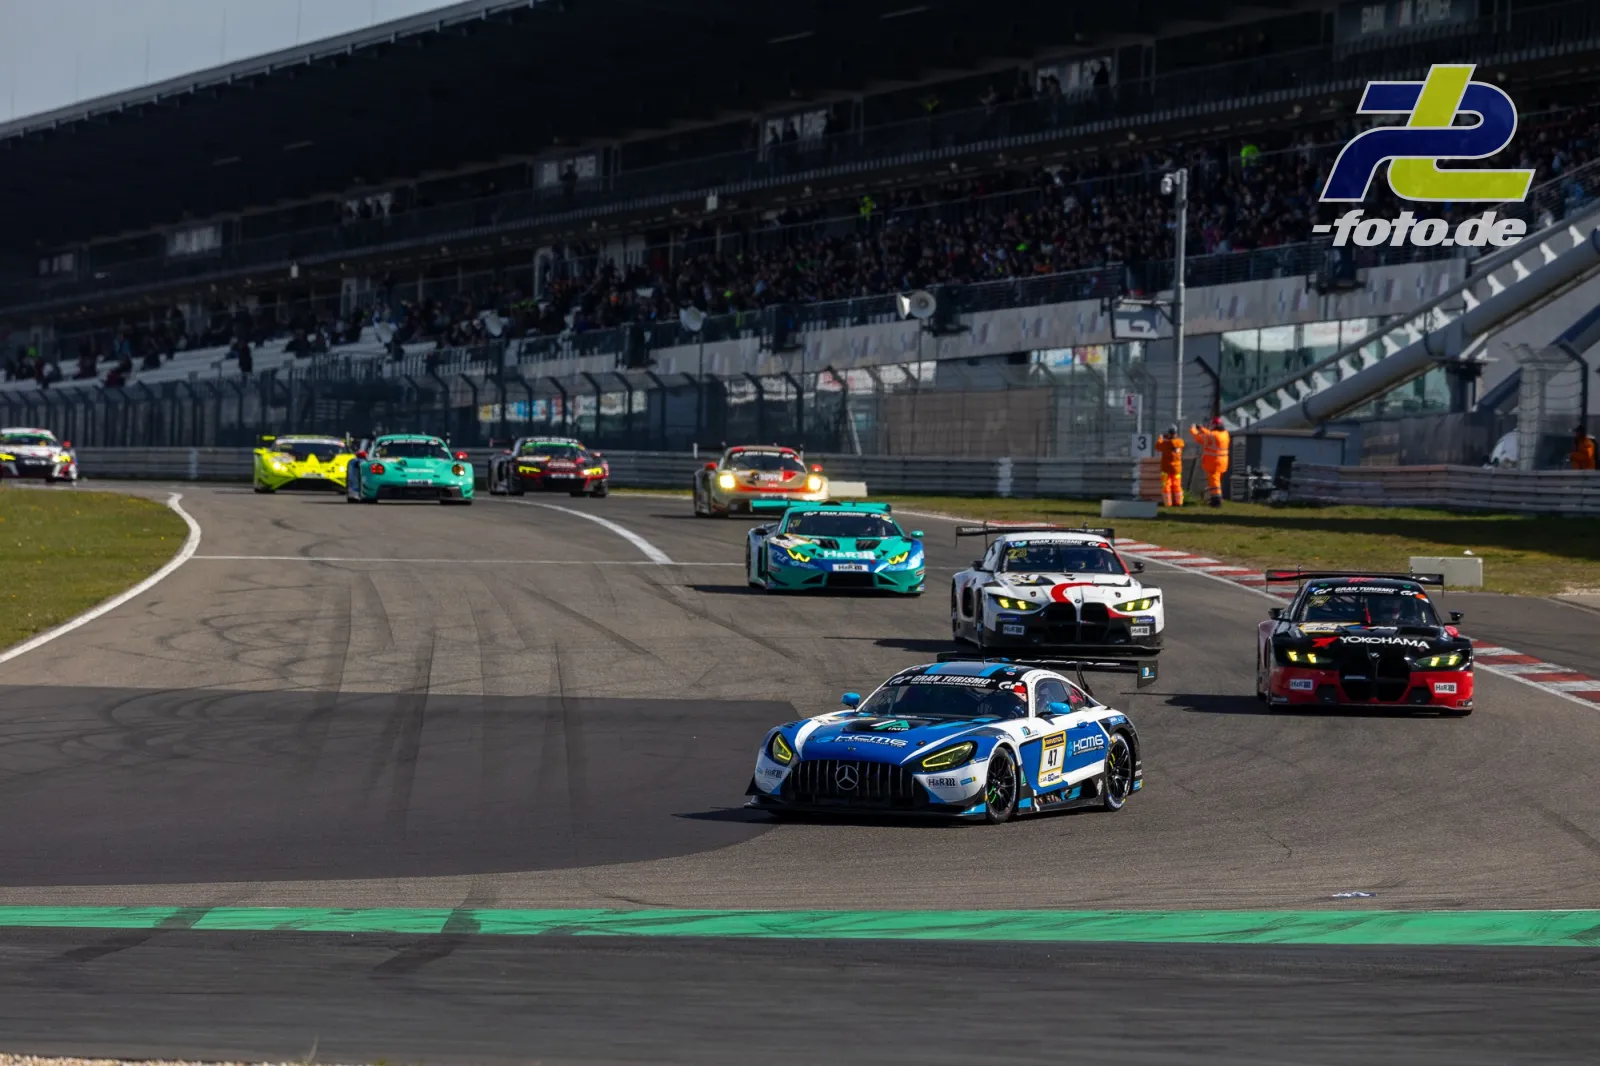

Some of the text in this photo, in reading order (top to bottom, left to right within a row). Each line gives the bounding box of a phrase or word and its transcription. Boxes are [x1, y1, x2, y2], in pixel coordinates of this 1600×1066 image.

[1137, 436, 1147, 450] 3
[1339, 635, 1430, 649] YOKOHAMA
[912, 674, 940, 682] GRAN
[942, 675, 990, 685] TURISMO
[1047, 749, 1058, 766] 47
